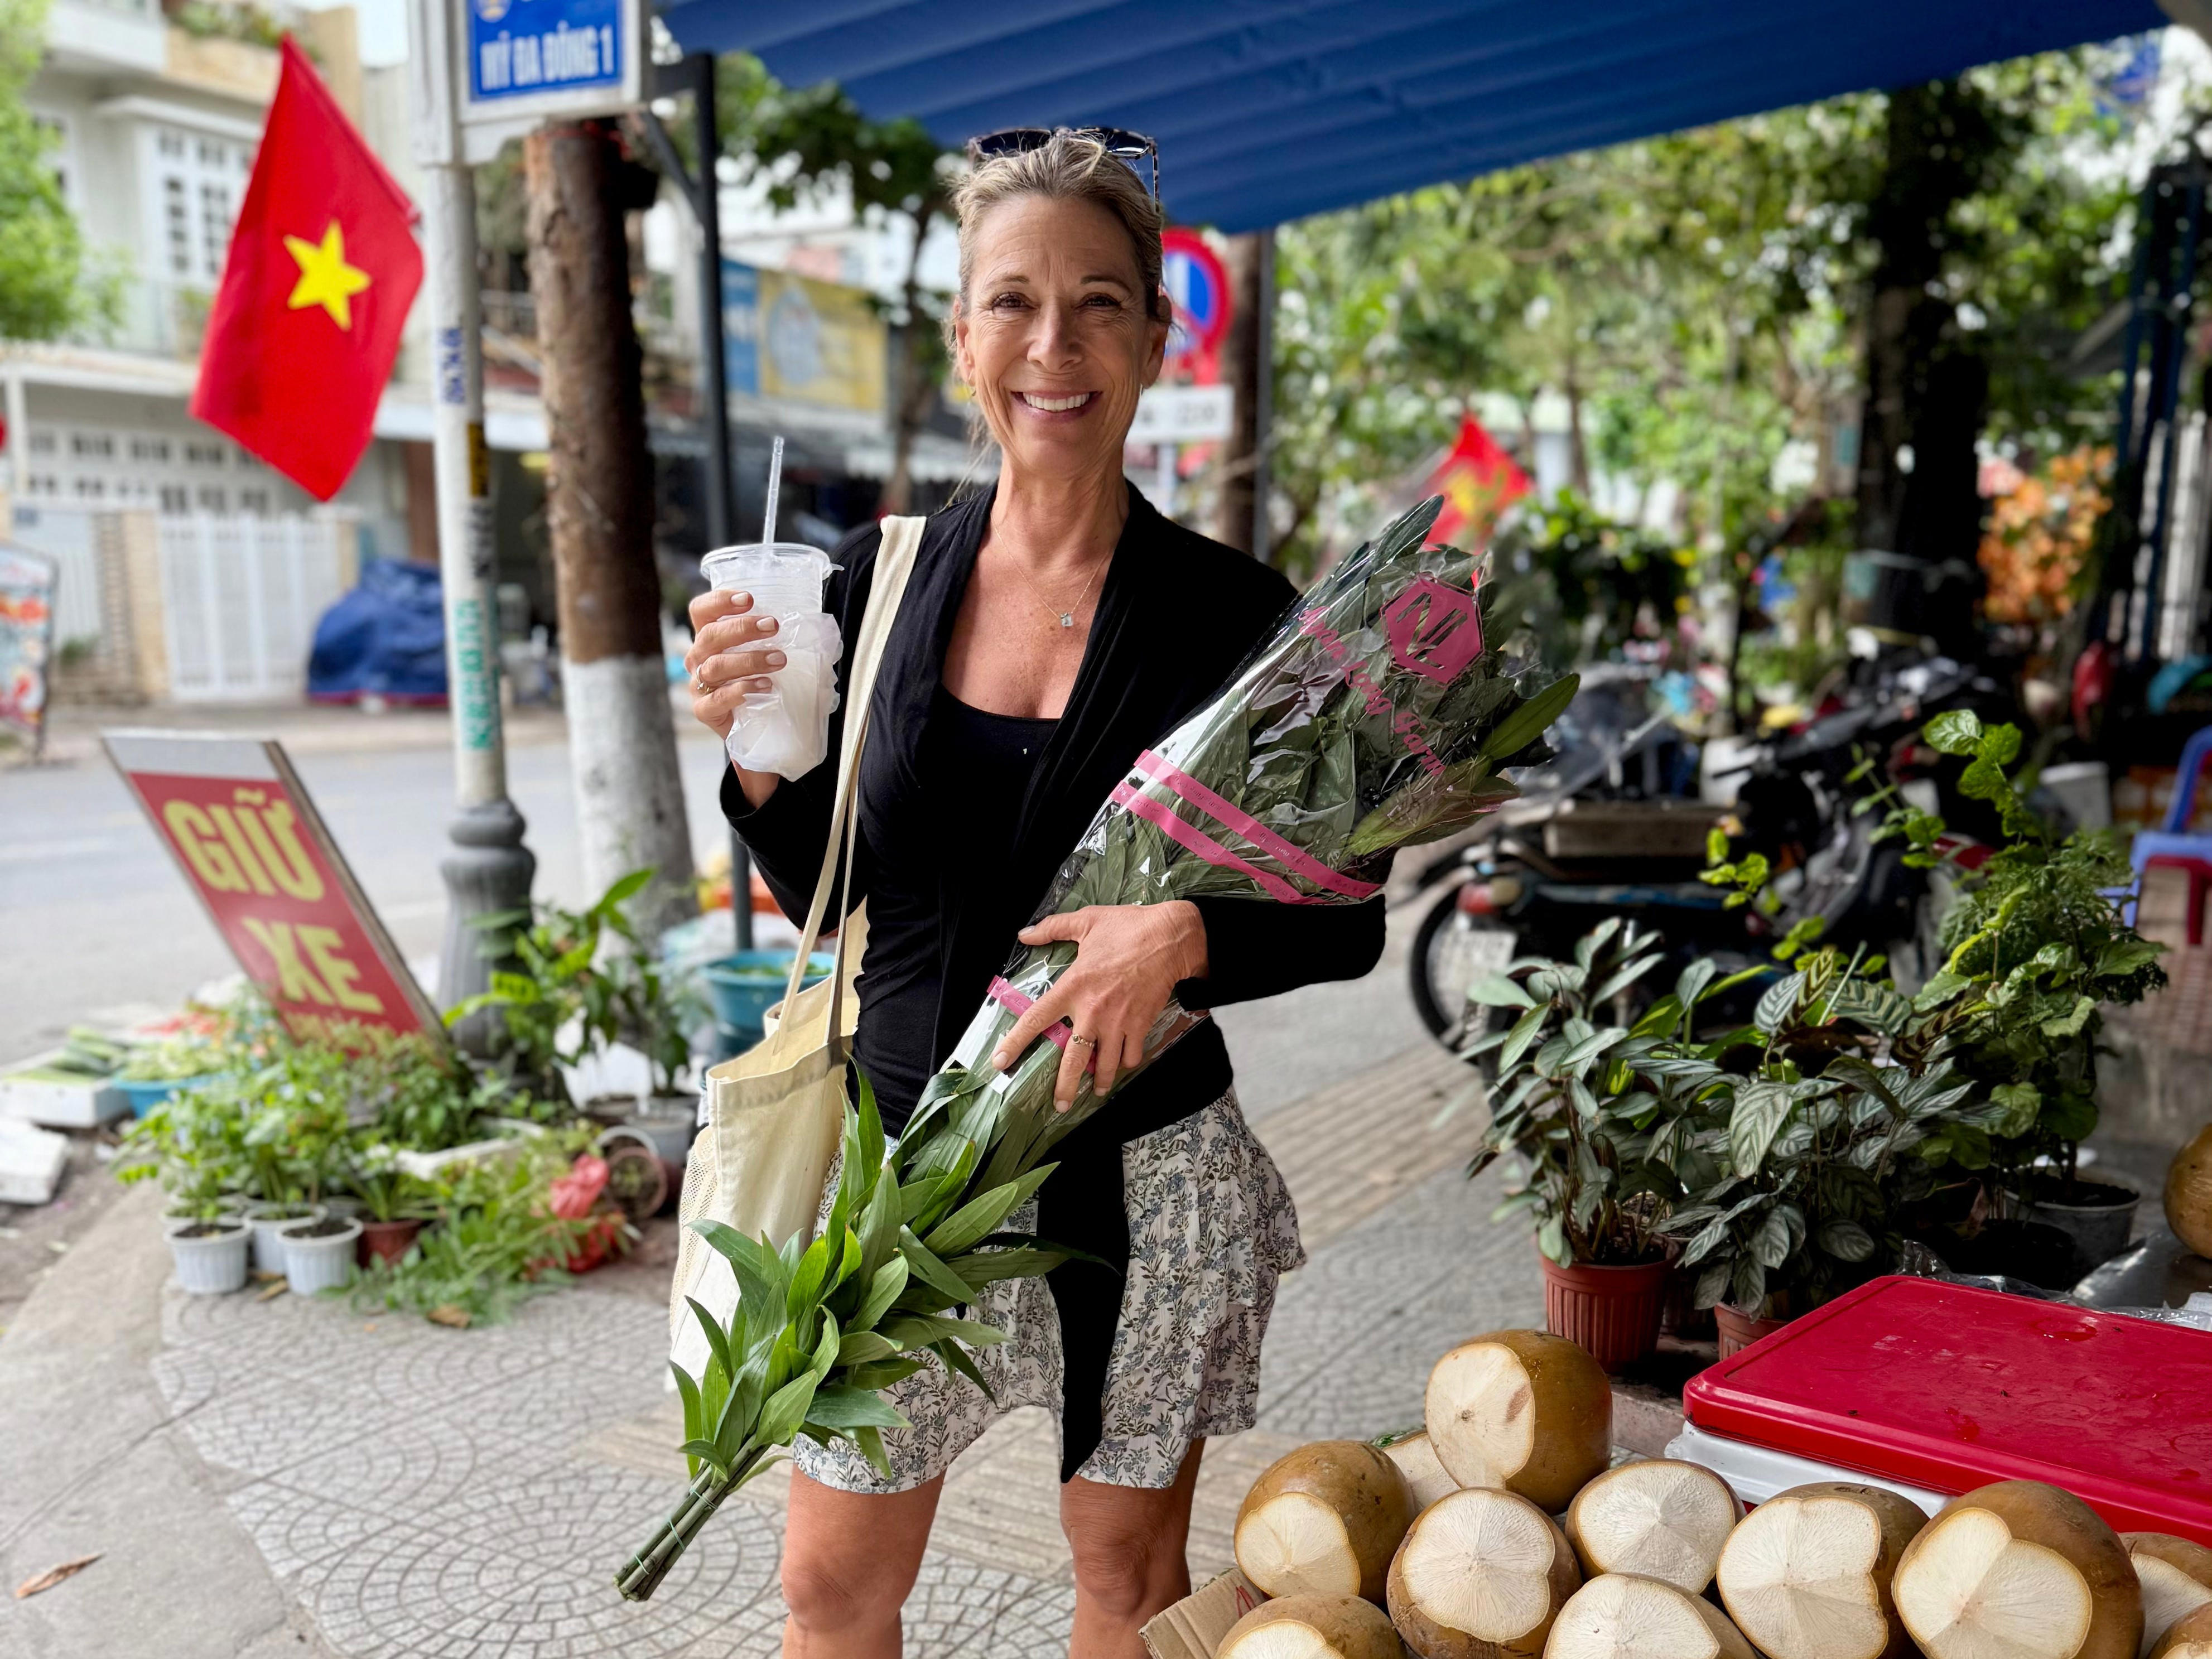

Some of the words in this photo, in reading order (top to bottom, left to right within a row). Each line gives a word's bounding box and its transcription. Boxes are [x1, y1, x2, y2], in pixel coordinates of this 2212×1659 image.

[600, 24, 614, 74] 1
[1341, 660, 1392, 715] Long
[1395, 712, 1446, 776] Farm
[163, 788, 325, 902] GIỮ
[242, 917, 384, 1014] XE
